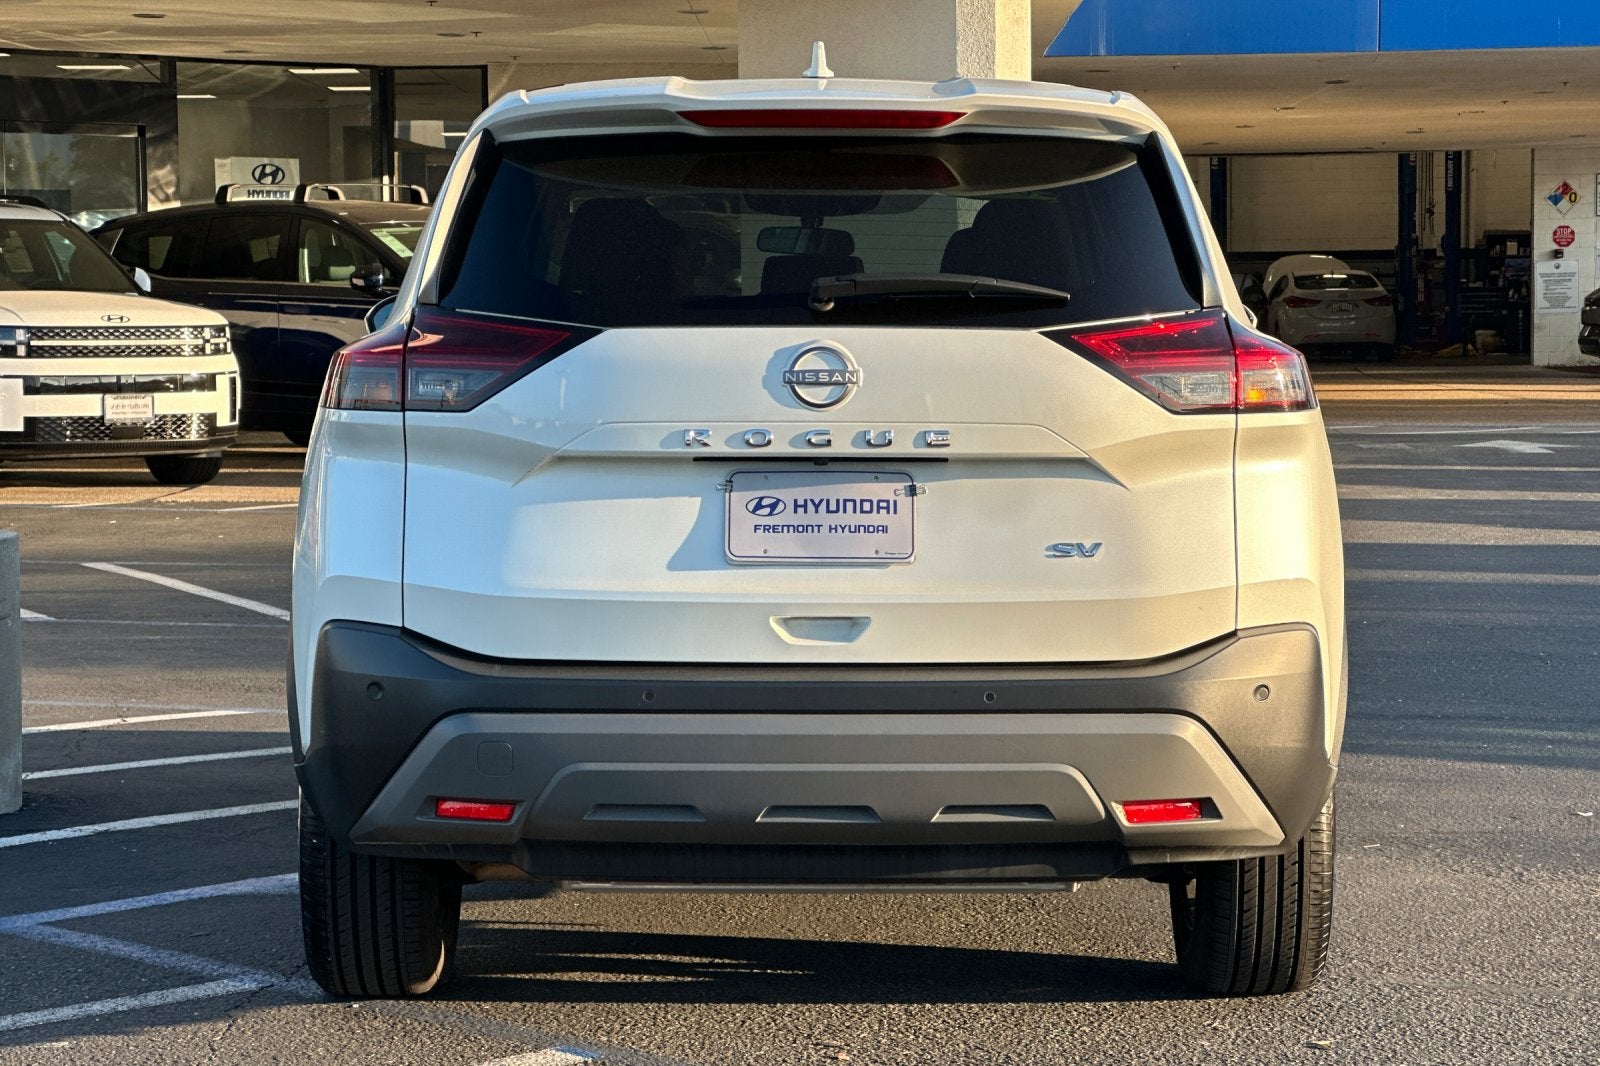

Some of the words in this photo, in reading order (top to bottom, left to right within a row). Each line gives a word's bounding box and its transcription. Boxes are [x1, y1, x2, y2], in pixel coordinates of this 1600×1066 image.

[1569, 192, 1577, 203] 0
[785, 371, 858, 383] NISSAN
[684, 428, 951, 448] ROGUE
[793, 498, 898, 515] HYUNDAI
[753, 524, 823, 534] FREMONT
[828, 524, 889, 534] HYUNDAI
[1050, 542, 1103, 558] SV
